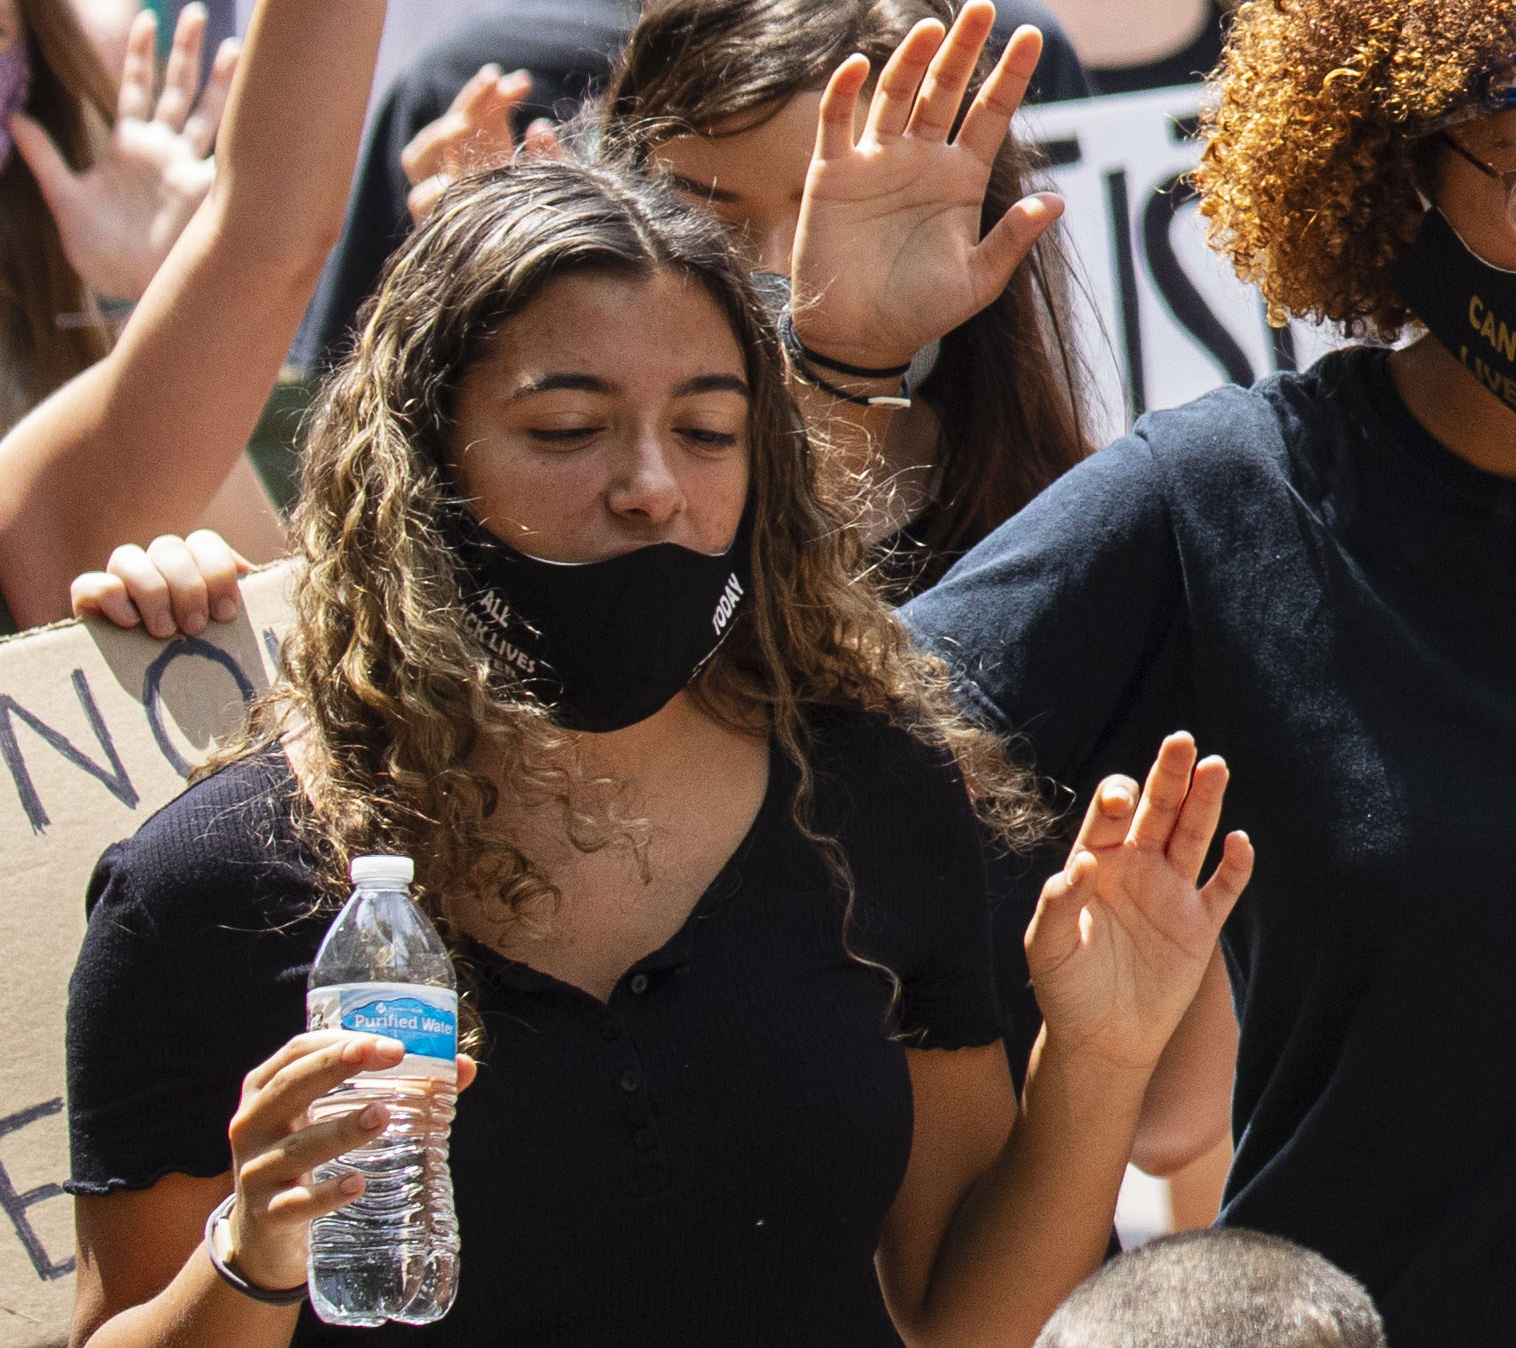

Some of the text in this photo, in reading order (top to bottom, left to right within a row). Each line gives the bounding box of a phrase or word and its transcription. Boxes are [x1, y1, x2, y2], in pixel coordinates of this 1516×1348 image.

[479, 571, 746, 636] ALL TODAY
[487, 632, 537, 675] LIVES
[354, 1014, 454, 1035] Purified Water
